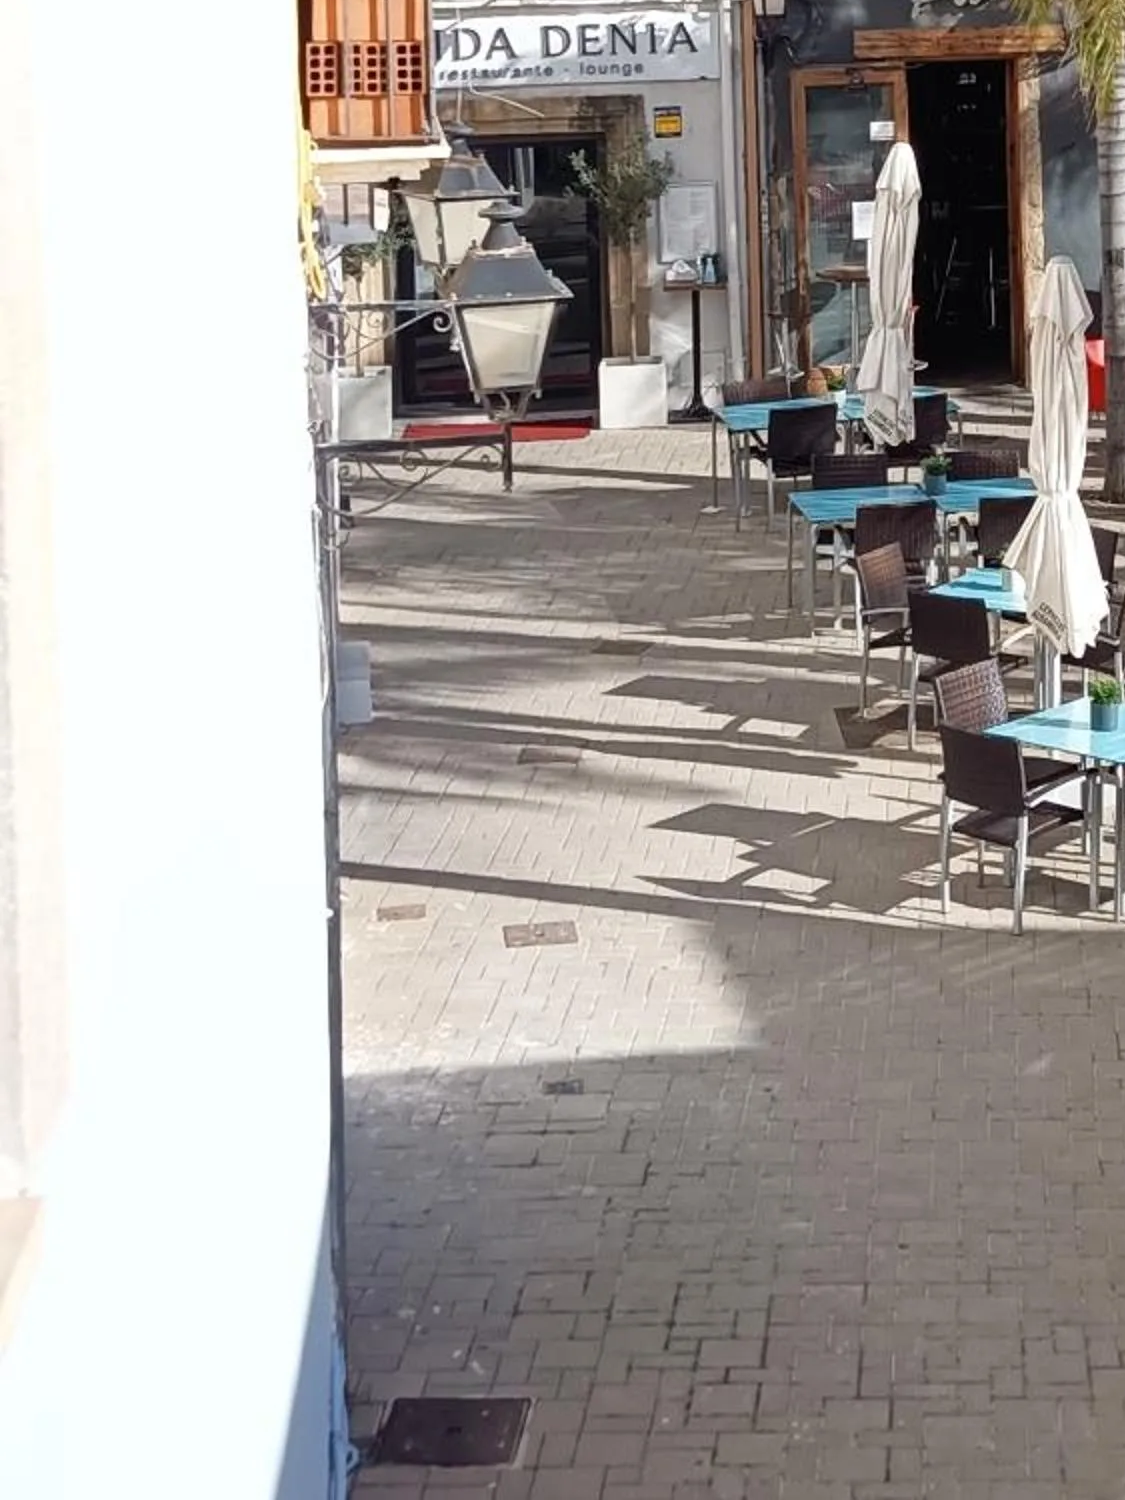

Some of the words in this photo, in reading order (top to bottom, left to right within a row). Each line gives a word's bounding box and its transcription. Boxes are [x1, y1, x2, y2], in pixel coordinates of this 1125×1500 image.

[540, 21, 698, 59] DENIA
[439, 65, 554, 81] restaurante
[579, 61, 644, 77] lounge
